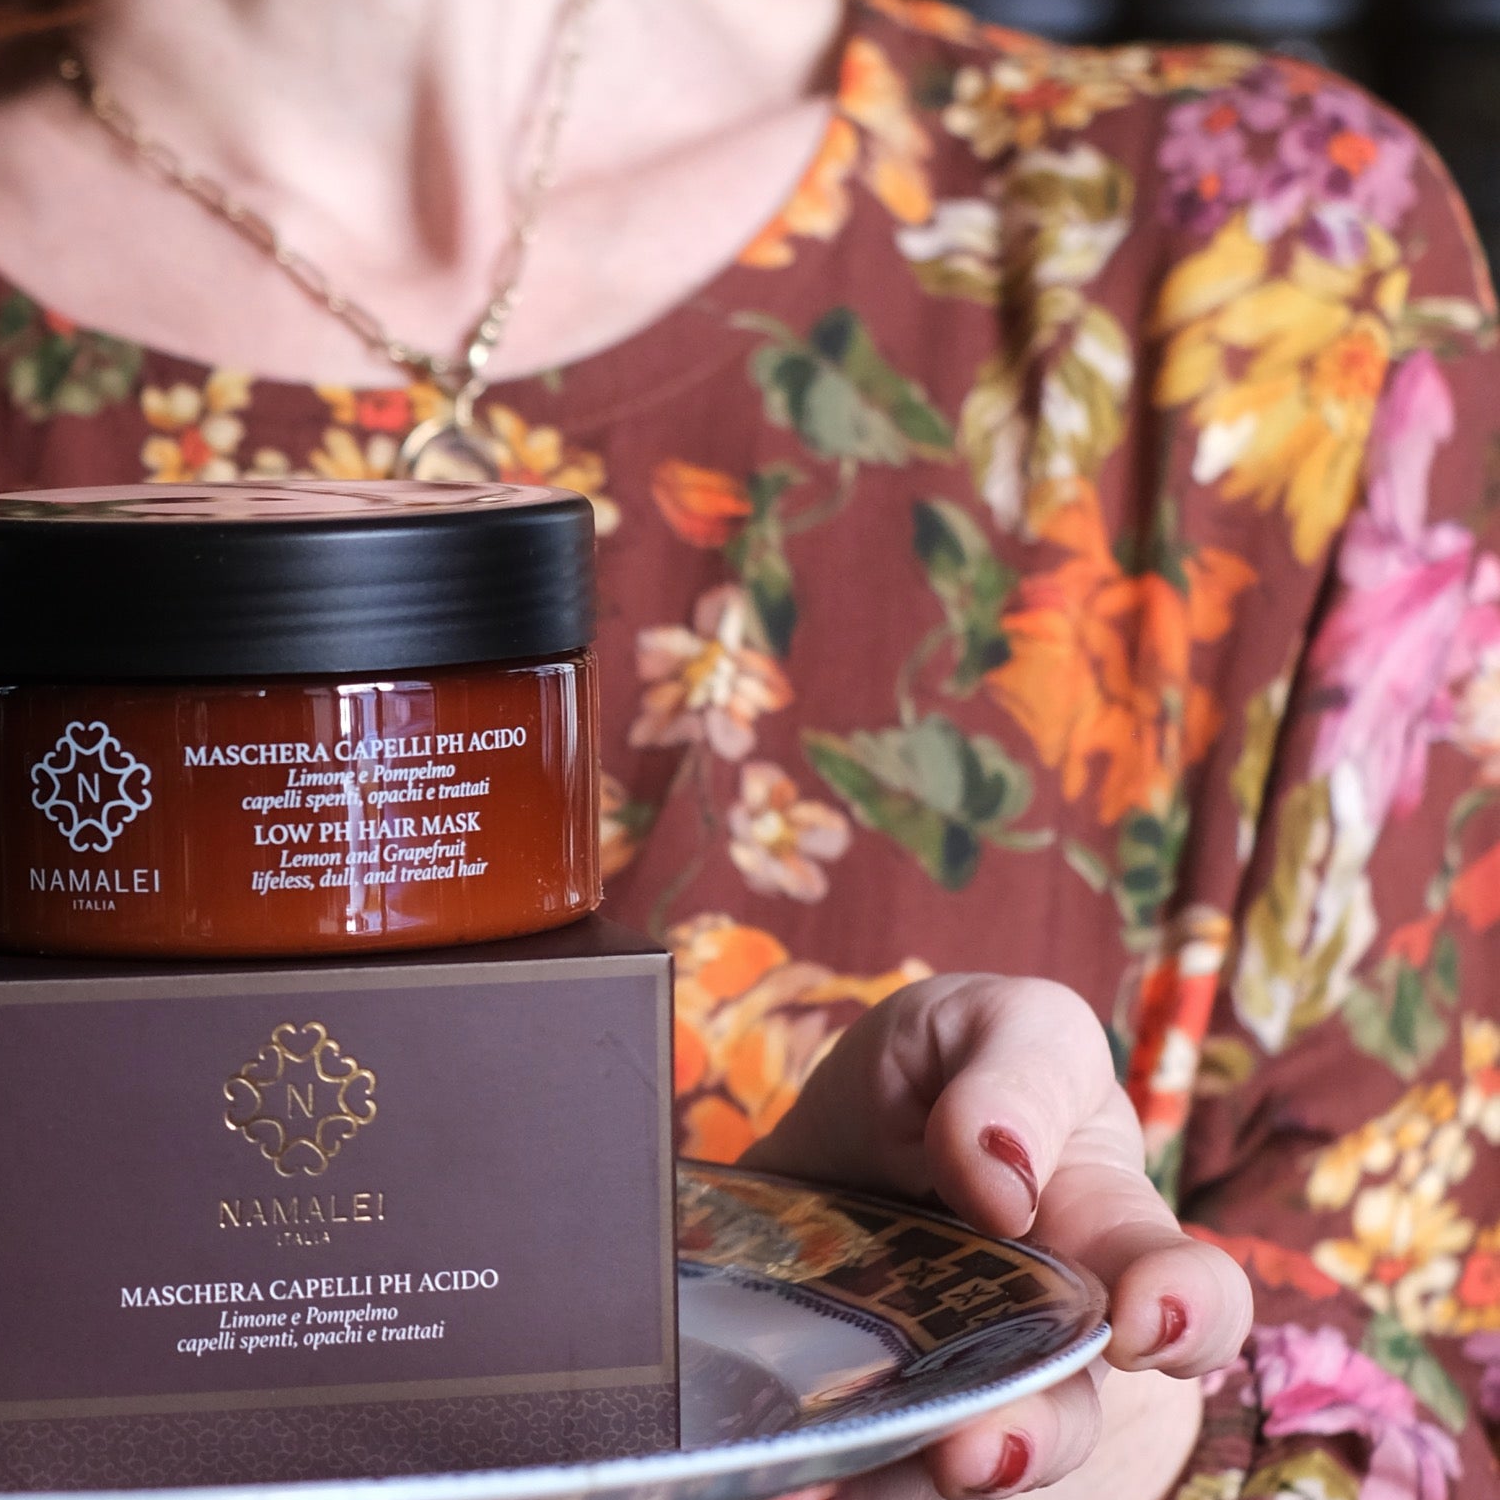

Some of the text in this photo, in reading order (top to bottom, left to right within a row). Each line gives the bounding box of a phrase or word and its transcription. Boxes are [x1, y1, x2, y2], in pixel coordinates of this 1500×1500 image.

[184, 726, 527, 766] MASCHERA CAPELLI PH ACIDO
[77, 772, 100, 803] N
[287, 760, 456, 787] Limone e Pompelmo
[242, 777, 490, 815] capelli spenti, opachi e trattati
[254, 811, 481, 846] LOW PH HAIR MASK
[280, 840, 466, 869] Lemon and Grapefruit
[30, 867, 160, 892] NAMALEI
[251, 857, 488, 895] lifeless, dull, and treated hair
[72, 899, 116, 911] ITALIA
[287, 1083, 314, 1119] N
[219, 1193, 385, 1228] NAMALEI
[120, 1268, 499, 1308] MASCHERA CAPELLI PH ACIDO
[219, 1303, 398, 1329] Limone e Pompelmo
[177, 1320, 446, 1357] capelli spenti, opachi e trattati
